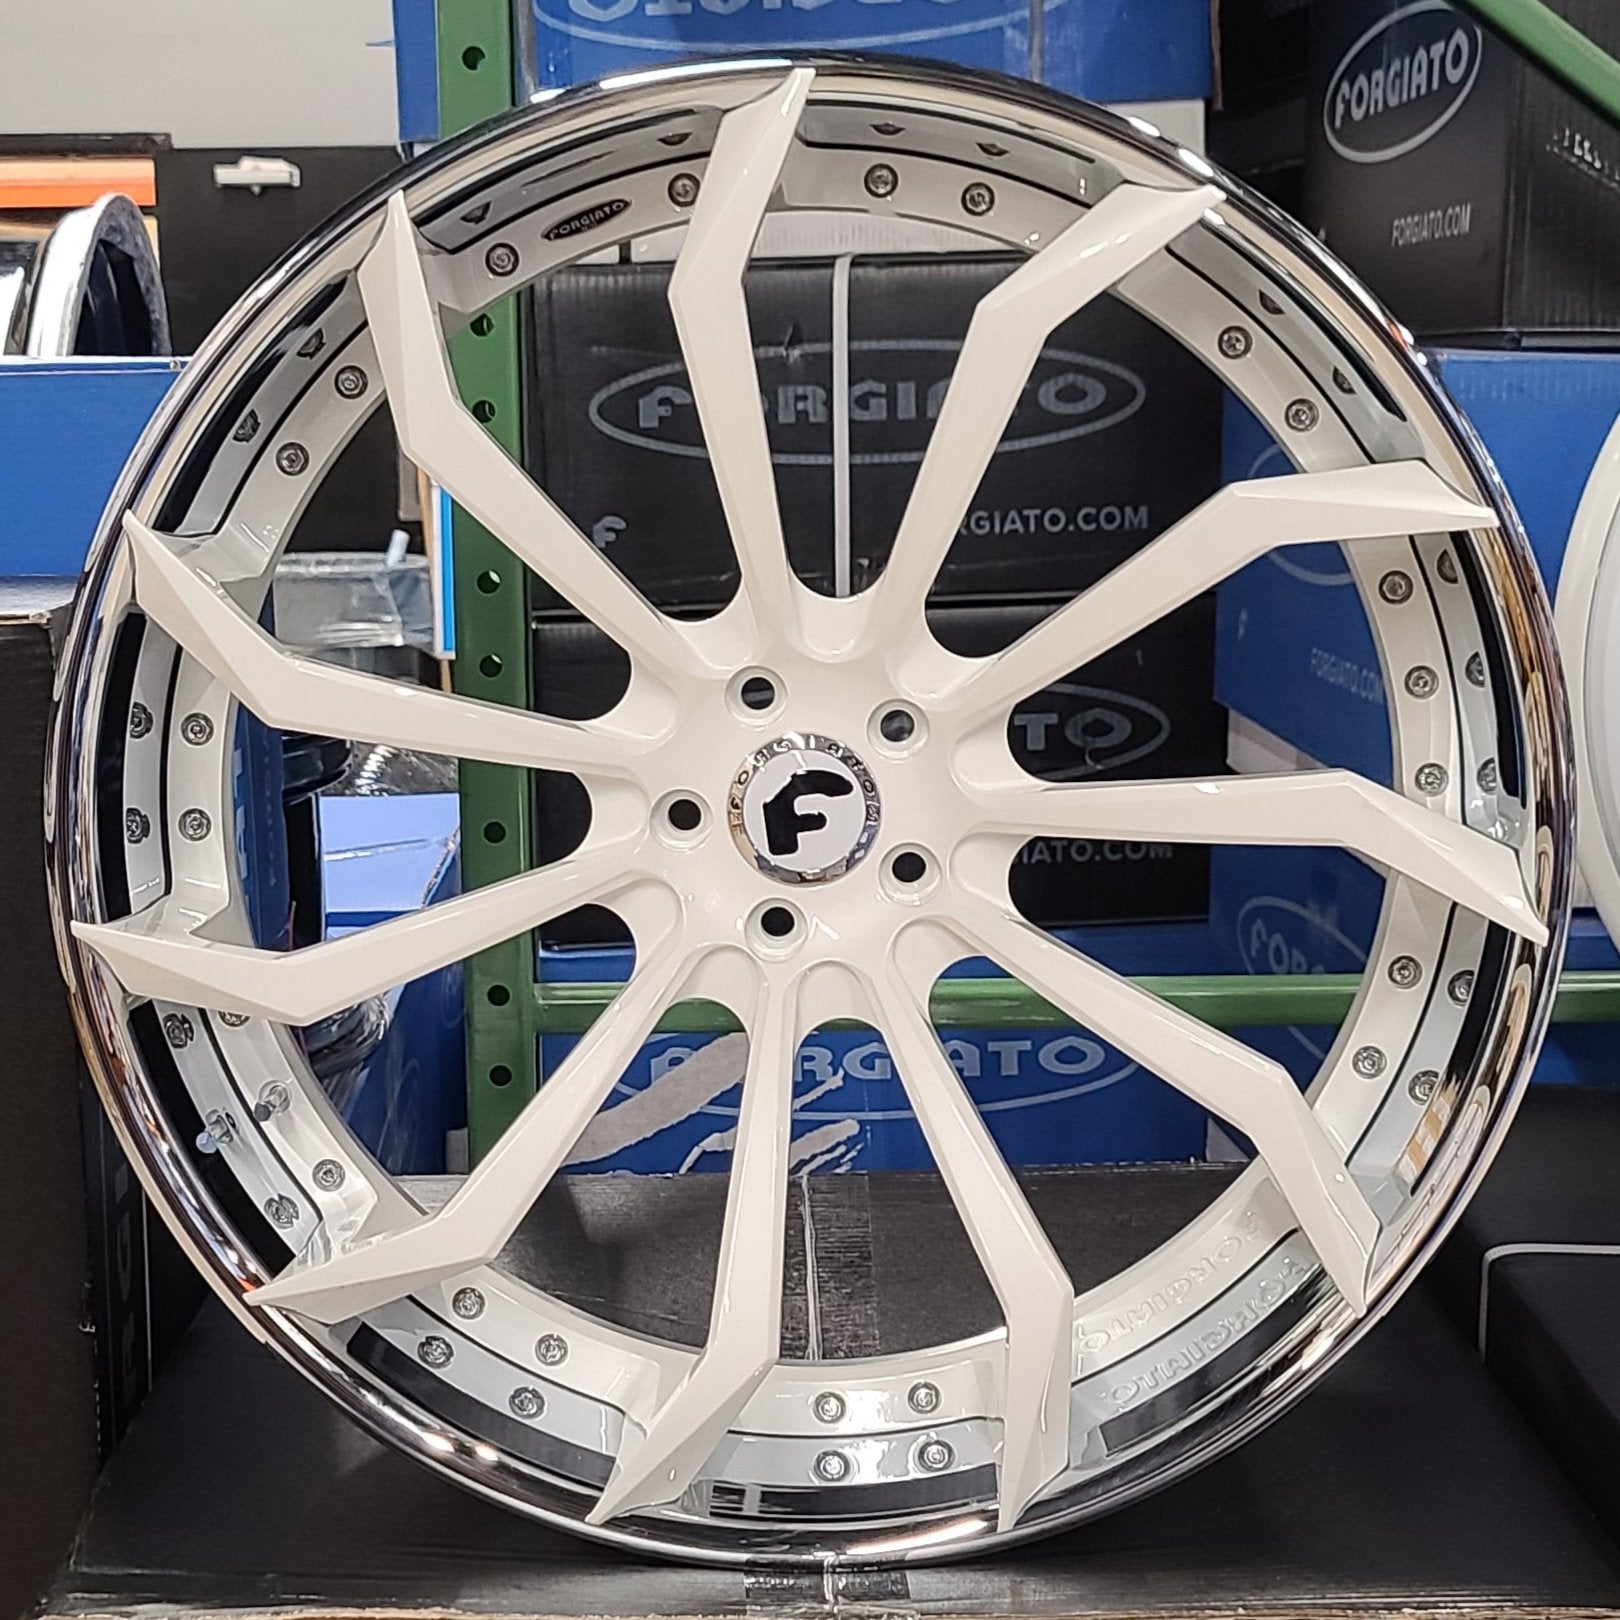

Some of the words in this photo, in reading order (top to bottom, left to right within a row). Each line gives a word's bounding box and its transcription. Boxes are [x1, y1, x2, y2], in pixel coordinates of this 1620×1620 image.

[1334, 27, 1470, 129] FORGIATO
[548, 201, 625, 240] FORGIATO
[1391, 202, 1471, 248] FORGIATO.COM
[638, 372, 1107, 428] FRGIO
[593, 515, 627, 548] F
[762, 769, 854, 856] F
[1016, 838, 1173, 865] IATO.COM
